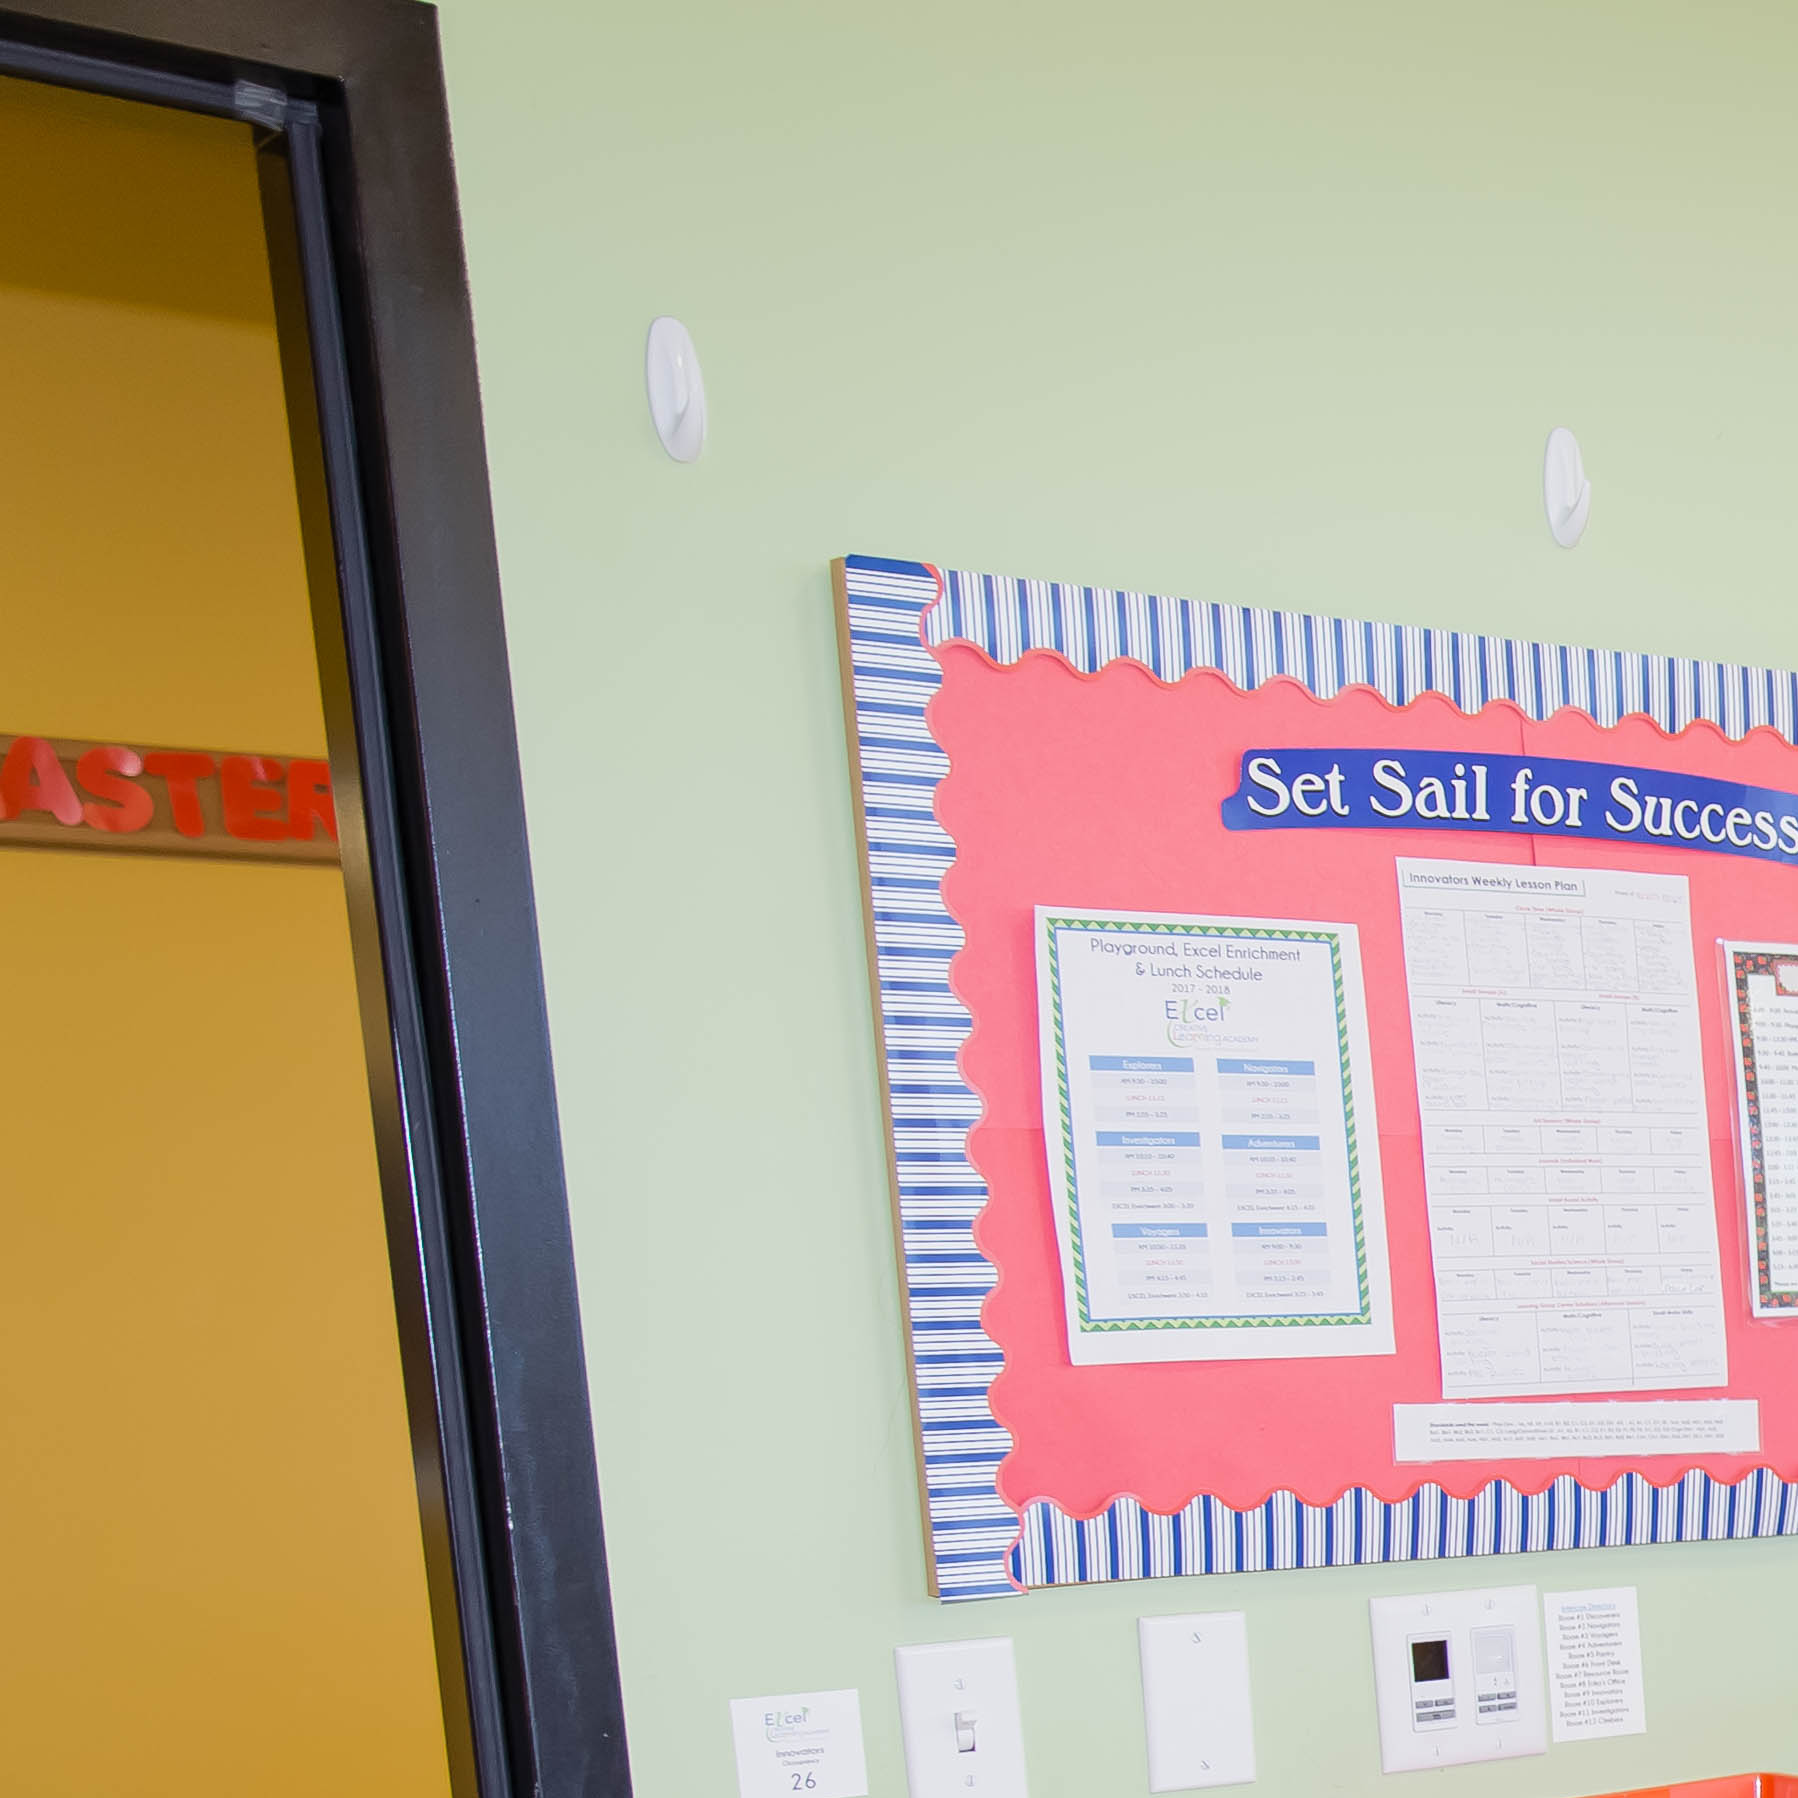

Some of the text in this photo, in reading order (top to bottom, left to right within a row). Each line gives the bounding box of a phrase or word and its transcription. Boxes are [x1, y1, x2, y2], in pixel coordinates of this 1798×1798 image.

[0, 736, 338, 841] ASTER
[1246, 757, 1350, 817] Set
[1369, 758, 1490, 822] Sail
[1511, 769, 1587, 827] for
[1409, 872, 1578, 892] Innovators Weekly Lesson Plan
[1090, 938, 1301, 961] Playground, Excel Enrichment
[1135, 963, 1263, 981] & Lunch Schedule
[1171, 983, 1196, 993] 2017
[1205, 984, 1231, 995] 2018
[791, 1771, 817, 1791] 26
